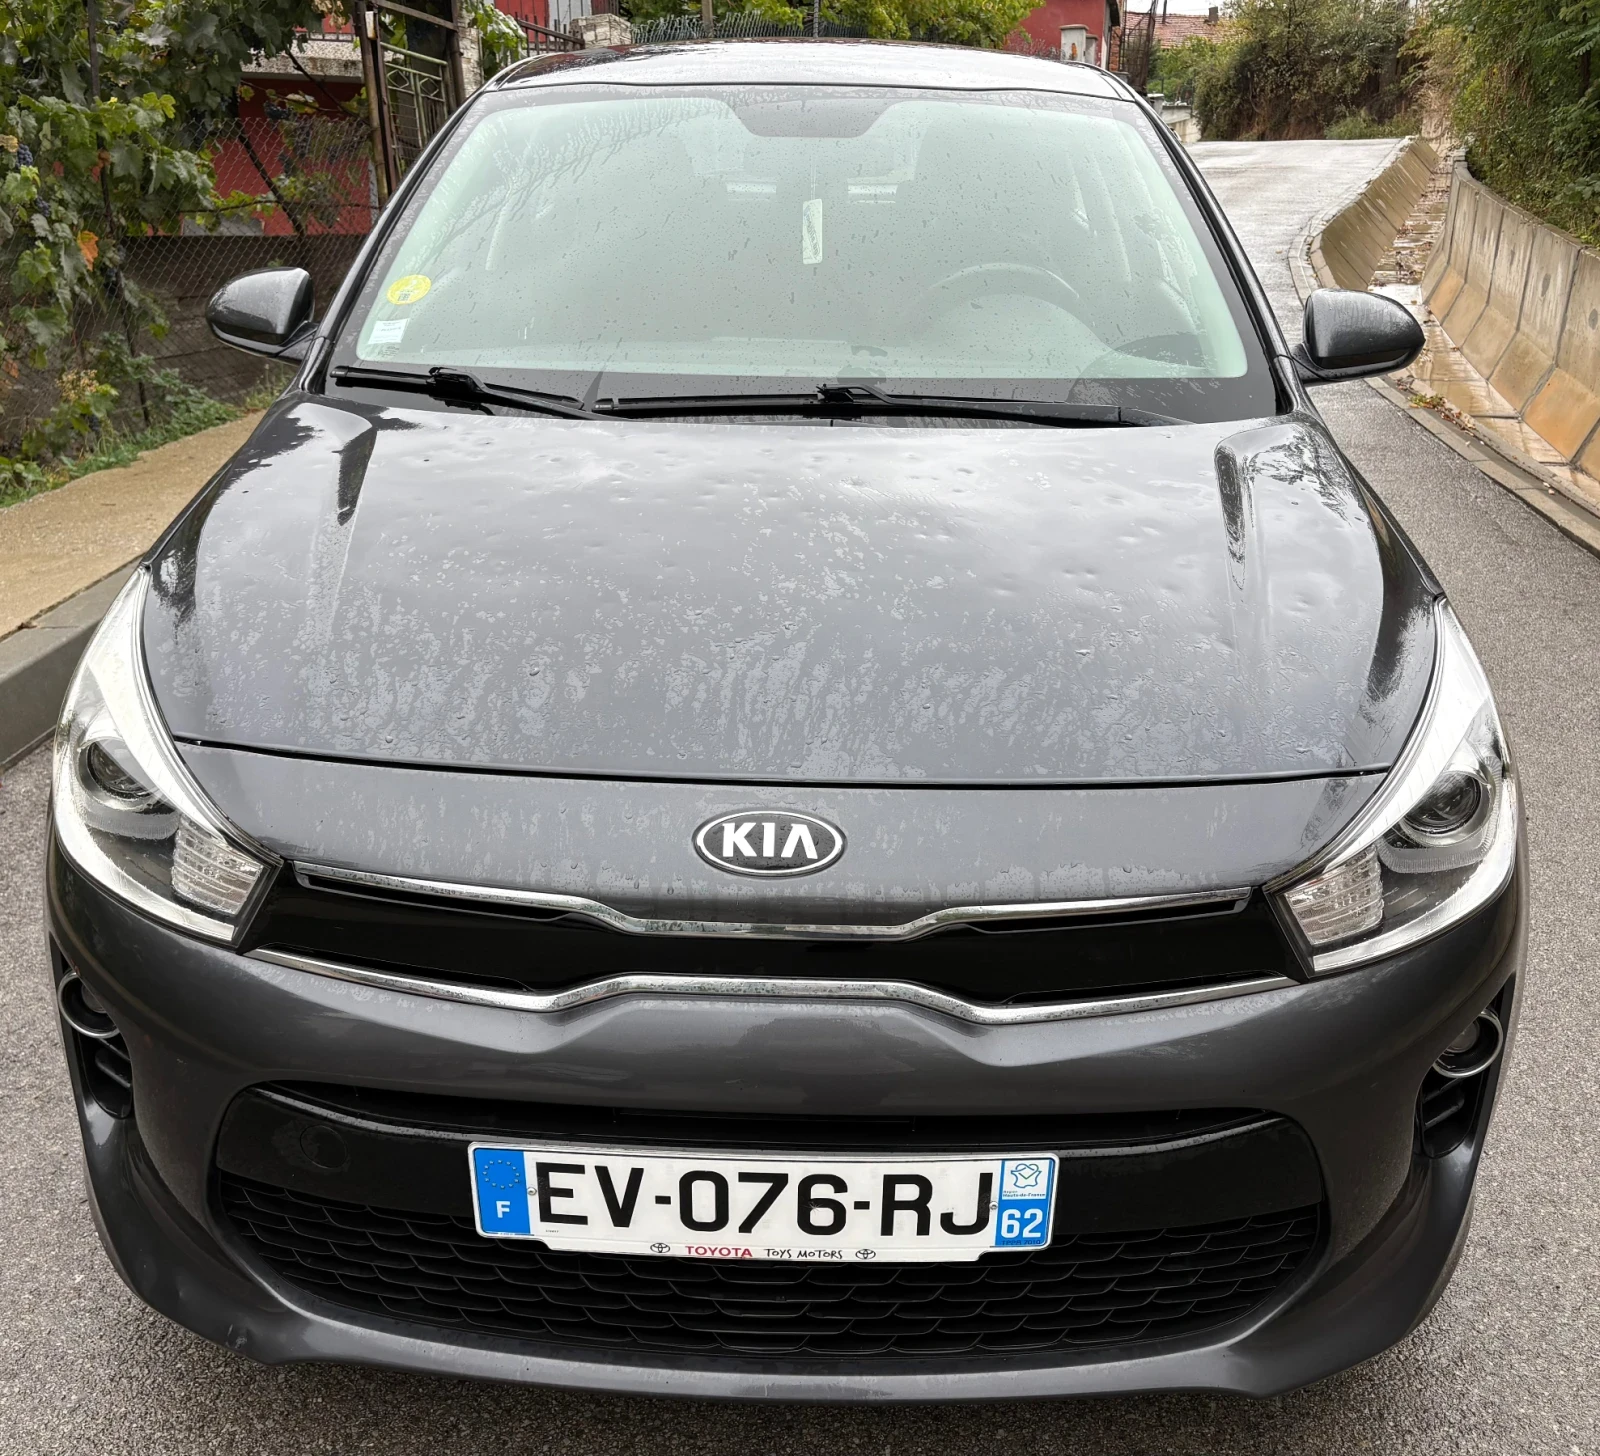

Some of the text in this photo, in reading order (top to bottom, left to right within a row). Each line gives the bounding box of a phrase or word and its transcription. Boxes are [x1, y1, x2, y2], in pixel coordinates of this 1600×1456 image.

[722, 822, 818, 859] KIA
[495, 1200, 511, 1219] F
[535, 1161, 993, 1237] EV-076-RJ
[1001, 1208, 1043, 1239] 62
[685, 1245, 753, 1257] TOYOTA
